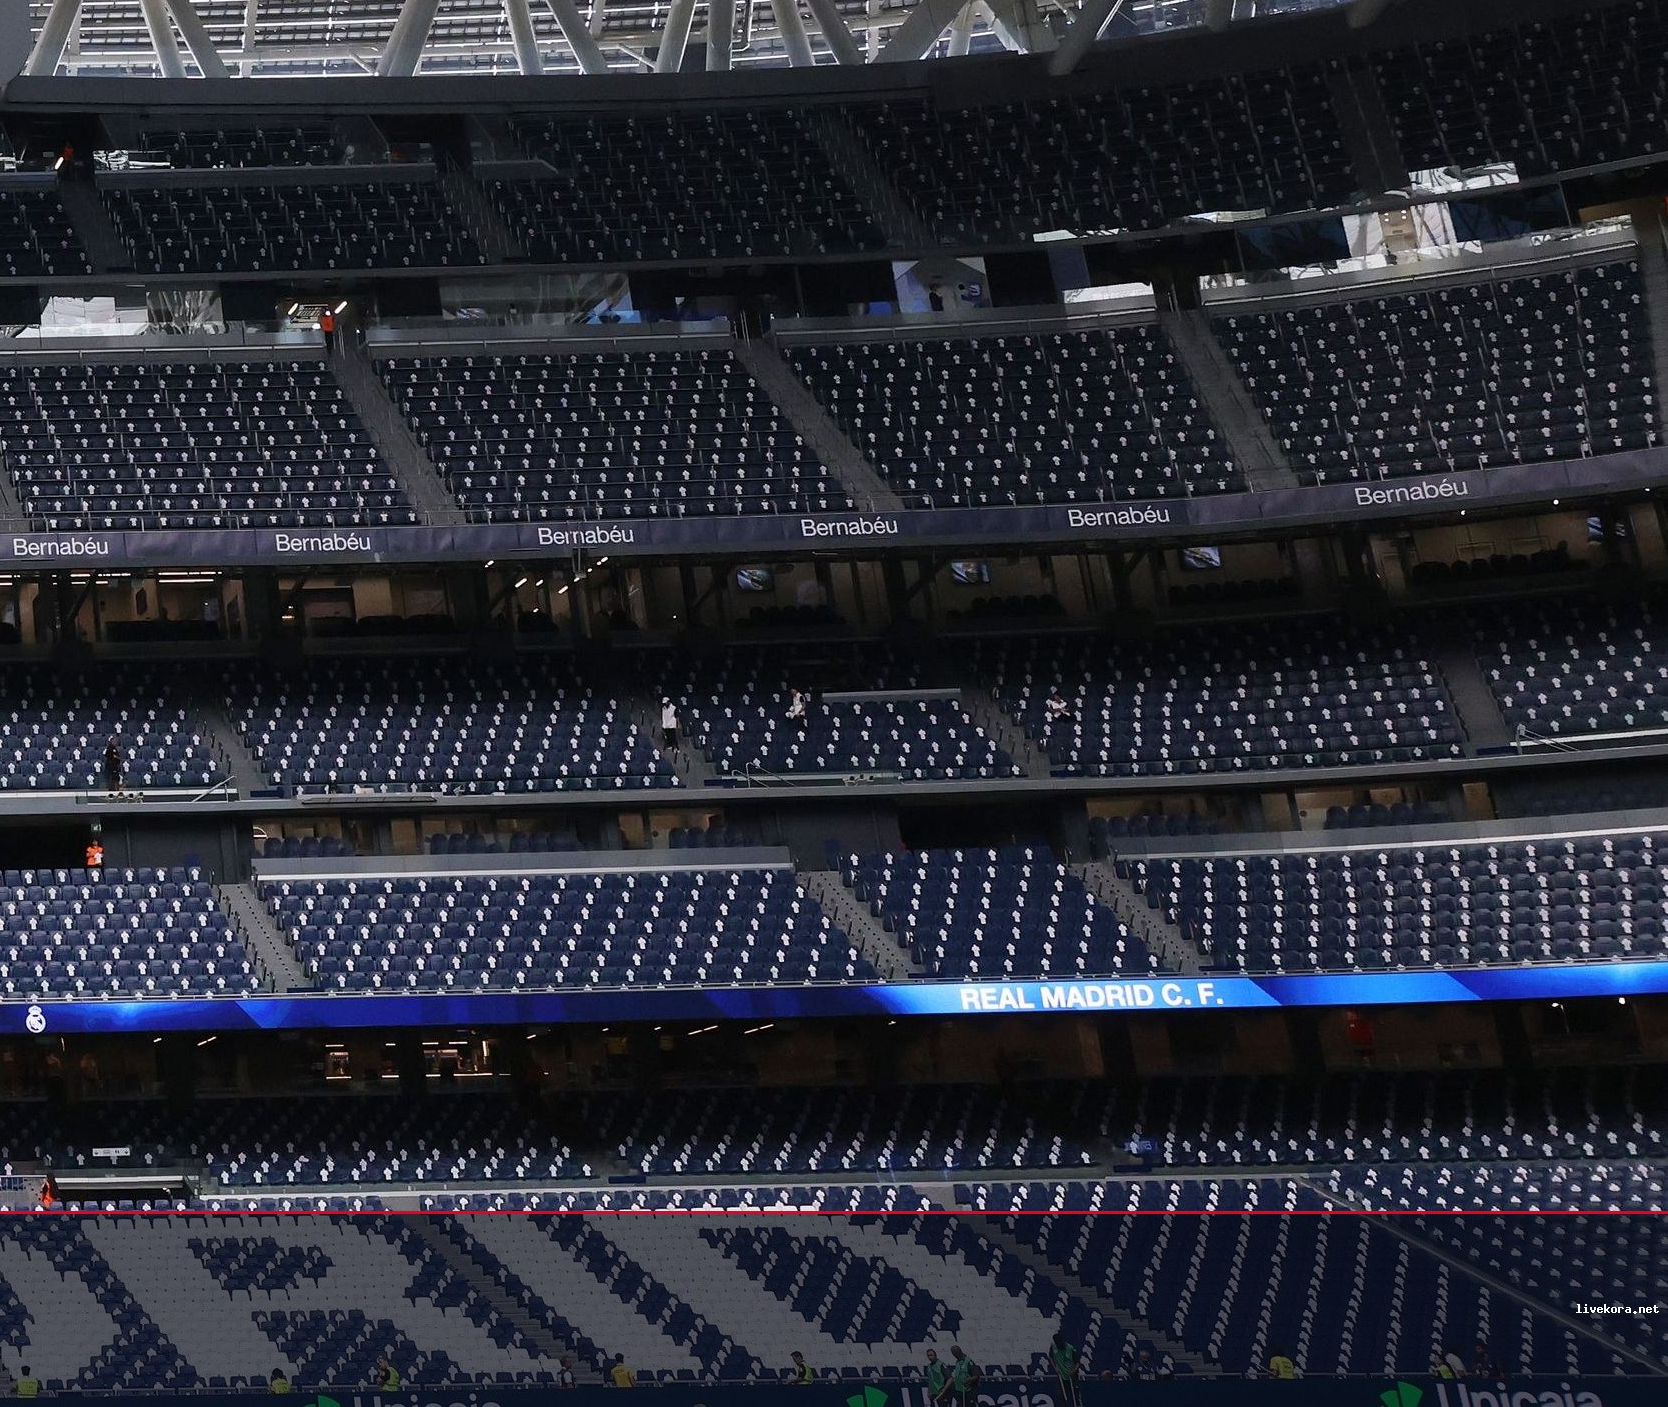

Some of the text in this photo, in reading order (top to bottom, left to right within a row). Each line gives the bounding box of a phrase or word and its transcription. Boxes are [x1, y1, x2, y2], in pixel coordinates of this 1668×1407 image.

[1354, 478, 1469, 506] Bernabéu
[801, 516, 899, 537] Bernabéu
[1067, 506, 1170, 528] Bernabéu
[13, 535, 109, 557] Bernabéu
[275, 530, 371, 552] Bernabéu
[538, 525, 634, 545] Bernabéu
[960, 982, 1224, 1010] REAL MADRID C. F.
